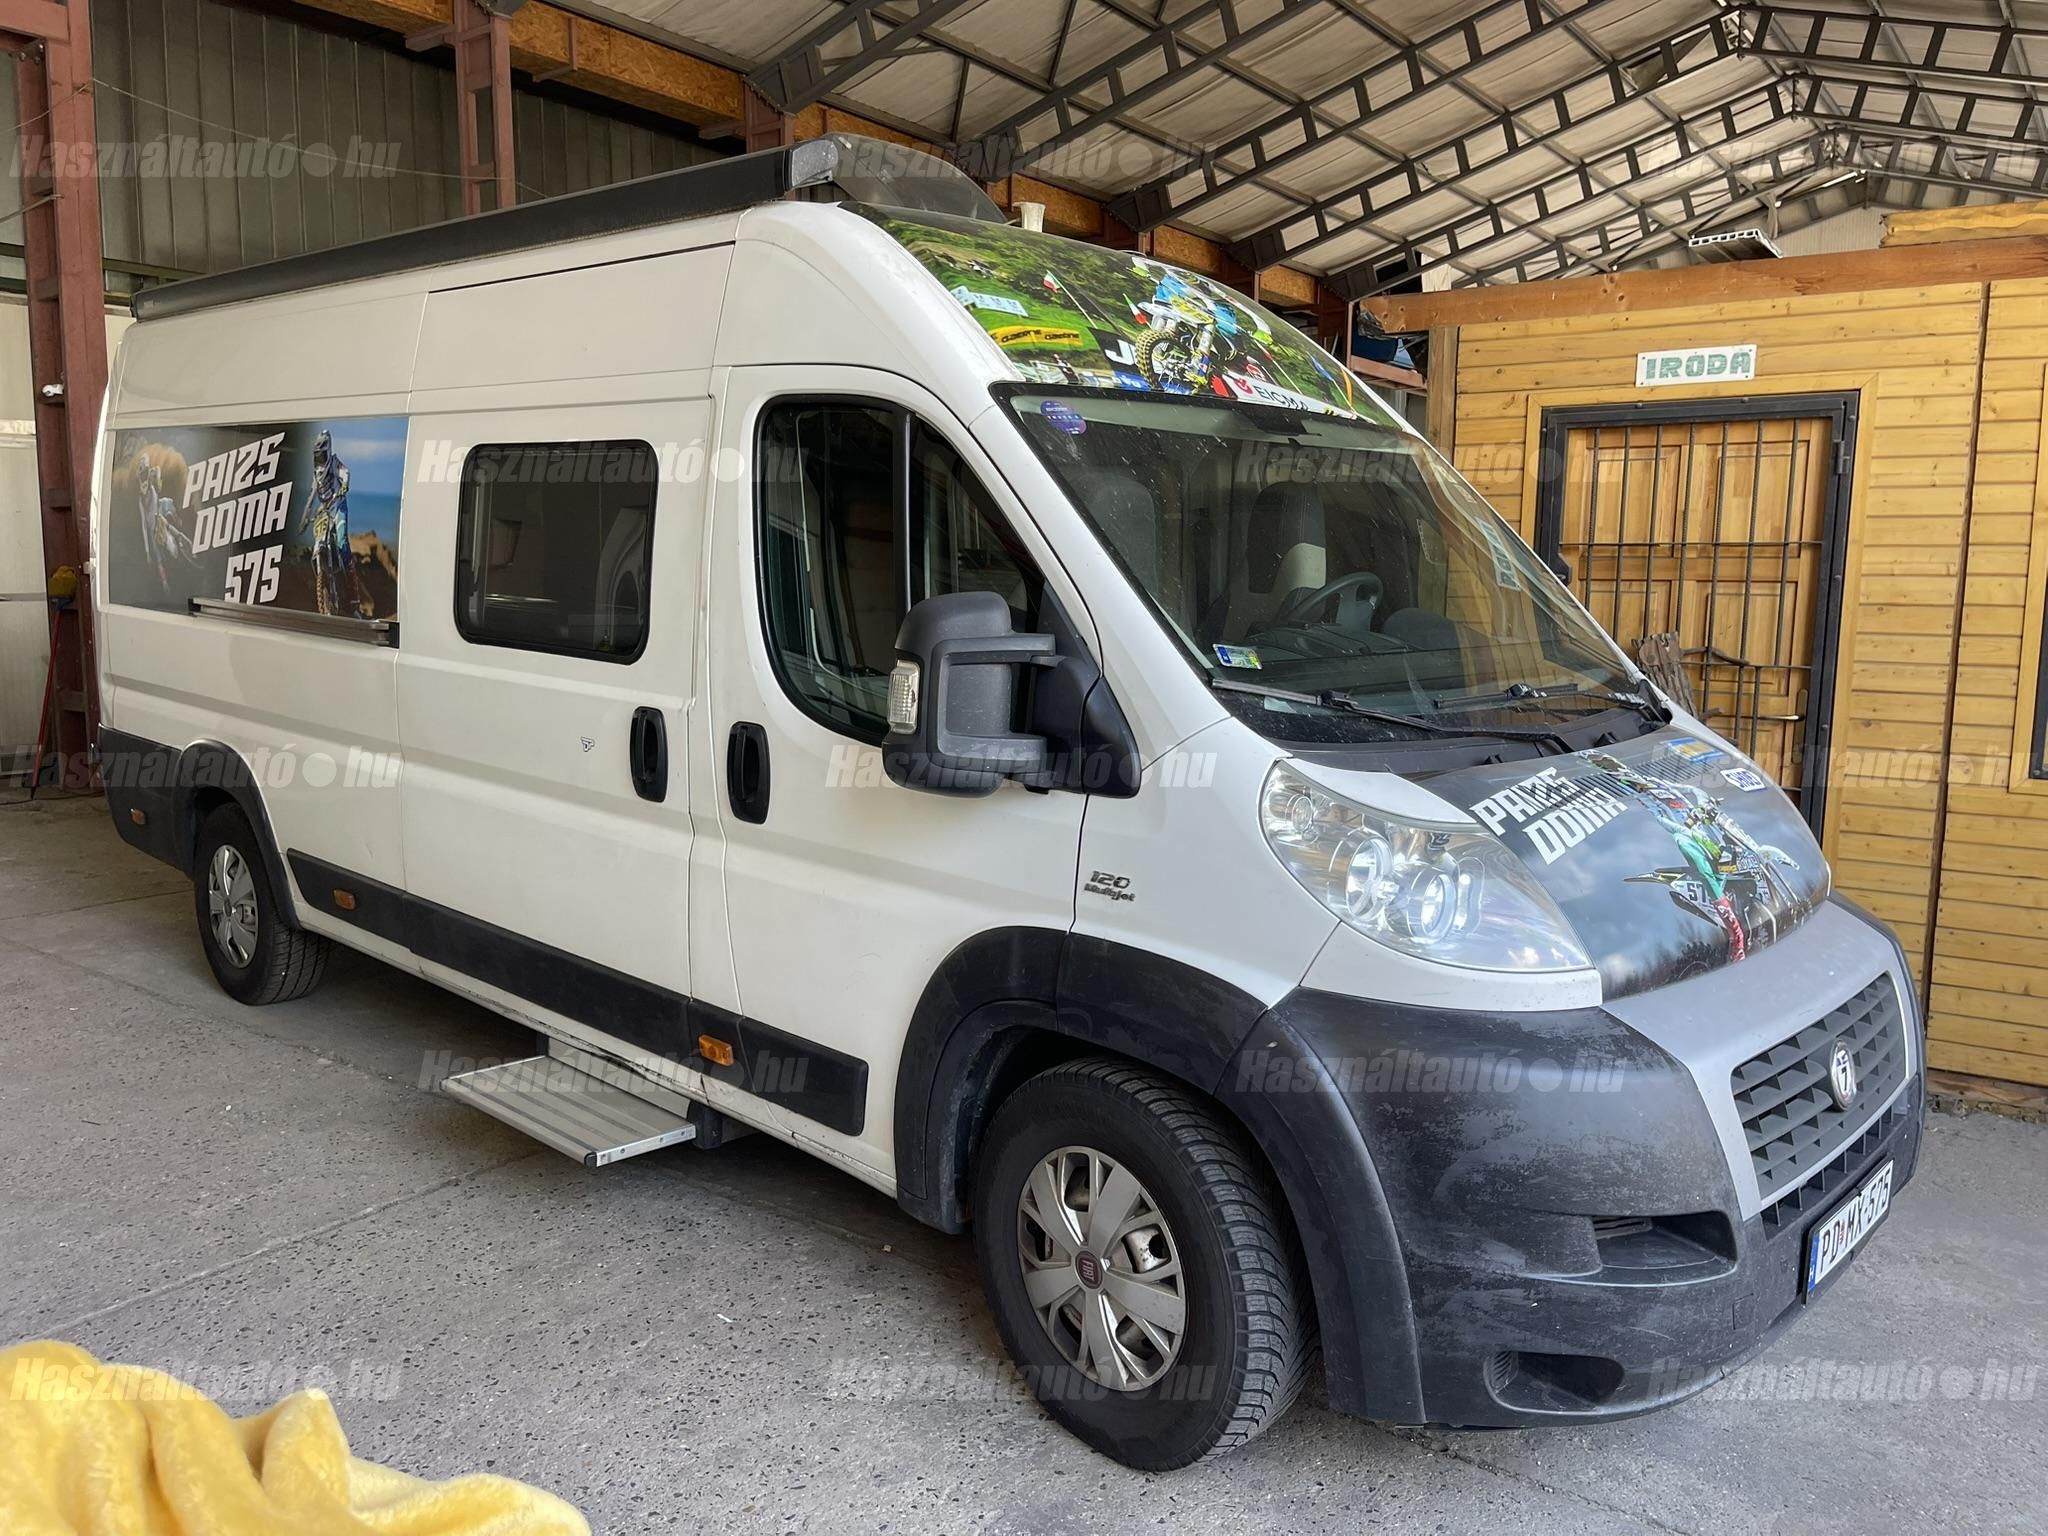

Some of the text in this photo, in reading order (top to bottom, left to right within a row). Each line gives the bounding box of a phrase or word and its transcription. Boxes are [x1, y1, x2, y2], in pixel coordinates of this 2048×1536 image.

[1646, 352, 1751, 379] IRODA
[192, 481, 293, 554] DOMA
[224, 544, 284, 606] 575
[1090, 870, 1131, 889] 120
